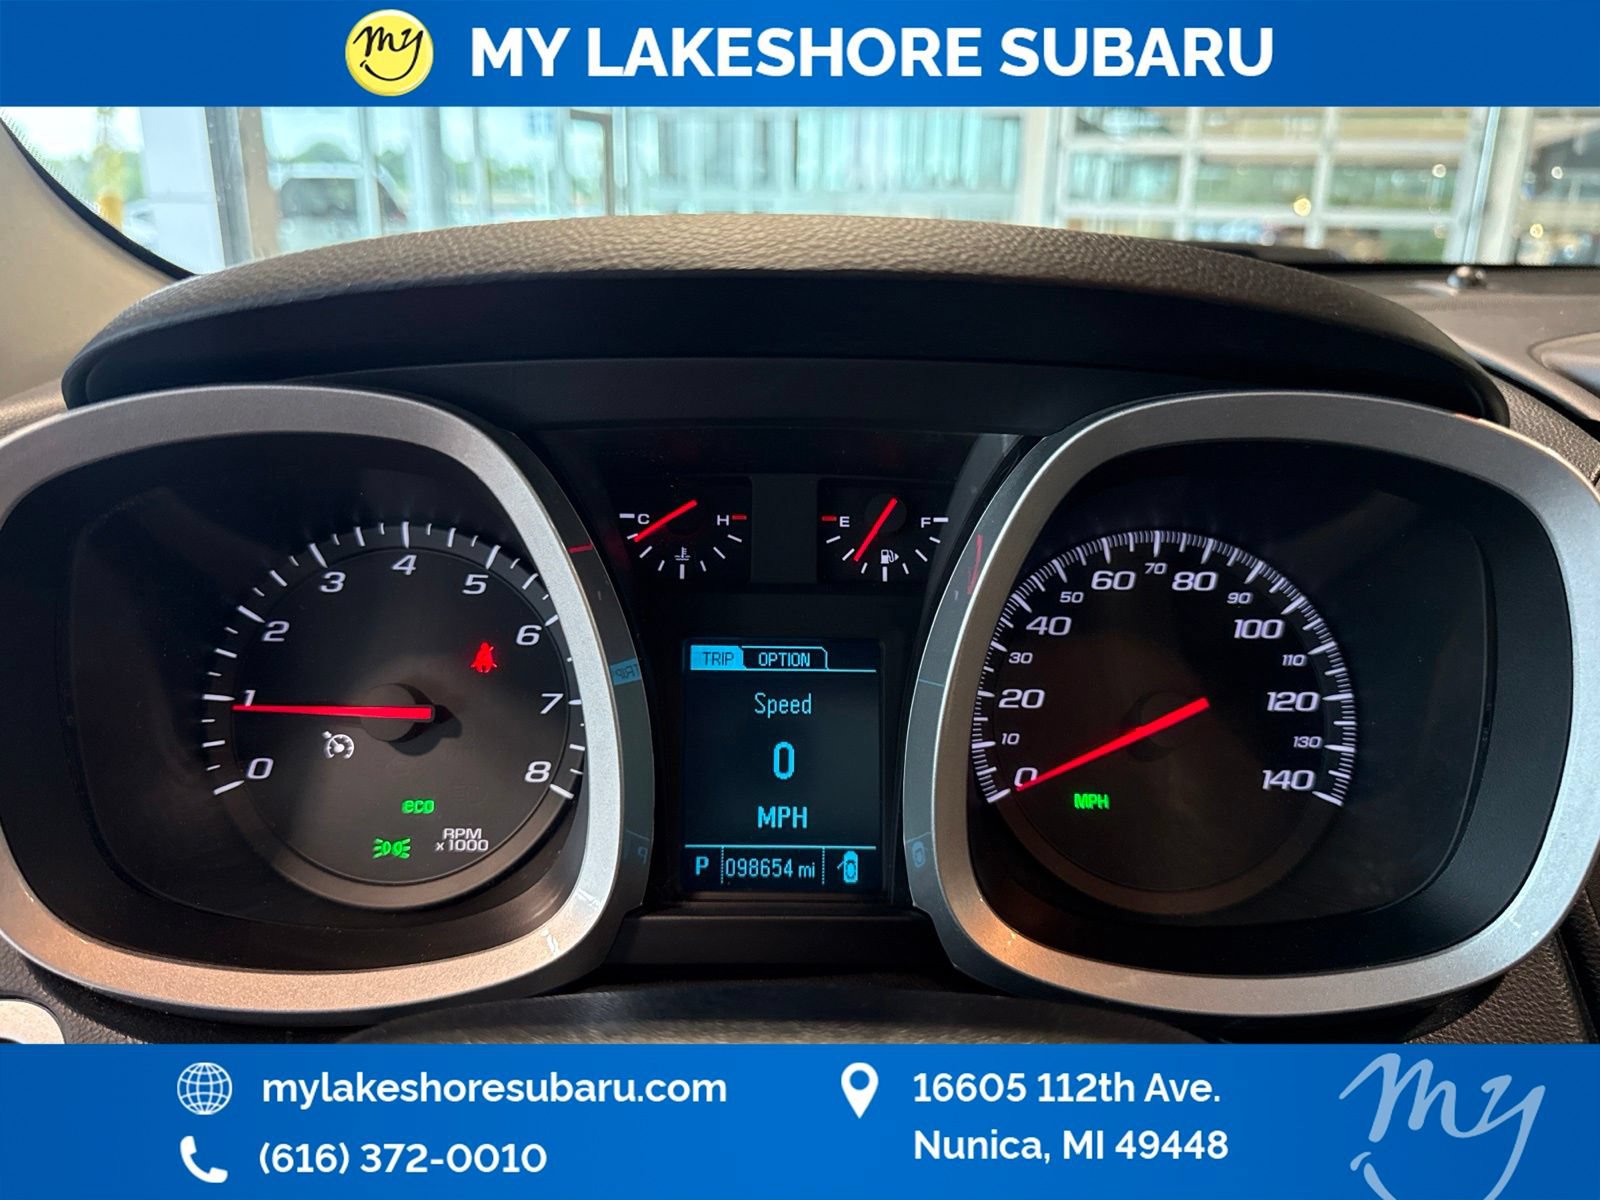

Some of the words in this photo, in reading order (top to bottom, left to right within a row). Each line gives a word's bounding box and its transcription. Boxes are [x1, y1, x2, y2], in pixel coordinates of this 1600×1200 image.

[637, 513, 650, 525] C
[716, 514, 730, 526] H
[839, 516, 850, 528] E
[920, 517, 931, 529] F
[392, 554, 417, 576] 4
[1145, 562, 1167, 575] 70
[320, 571, 346, 593] 3
[462, 574, 489, 595] 5
[1091, 570, 1136, 590] 60
[1171, 571, 1217, 591] 80
[1059, 591, 1084, 603] 50
[1227, 592, 1252, 604] 90
[262, 622, 290, 641] 2
[516, 624, 542, 646] 6
[1026, 616, 1072, 636] 40
[1234, 619, 1284, 639] 100
[703, 651, 735, 666] TRIP
[757, 652, 811, 667] OPTION
[1008, 652, 1033, 664] 30
[1282, 654, 1306, 667] 110
[244, 689, 256, 706] 1
[540, 693, 564, 715] 7
[754, 692, 812, 719] Speed
[998, 688, 1045, 709] 20
[1267, 691, 1319, 712] 120
[1001, 733, 1020, 745] 10
[1293, 736, 1322, 748] 130
[247, 757, 274, 780] 0
[772, 741, 795, 780] 0
[525, 761, 551, 783] 8
[1014, 767, 1038, 787] 0
[1263, 770, 1314, 789] 140
[401, 799, 435, 815] eco
[1074, 793, 1109, 809] MPH
[757, 805, 808, 829] MPH
[442, 827, 483, 841] RPM
[695, 856, 710, 876] P
[725, 857, 794, 878] 098654
[798, 862, 816, 878] mi
